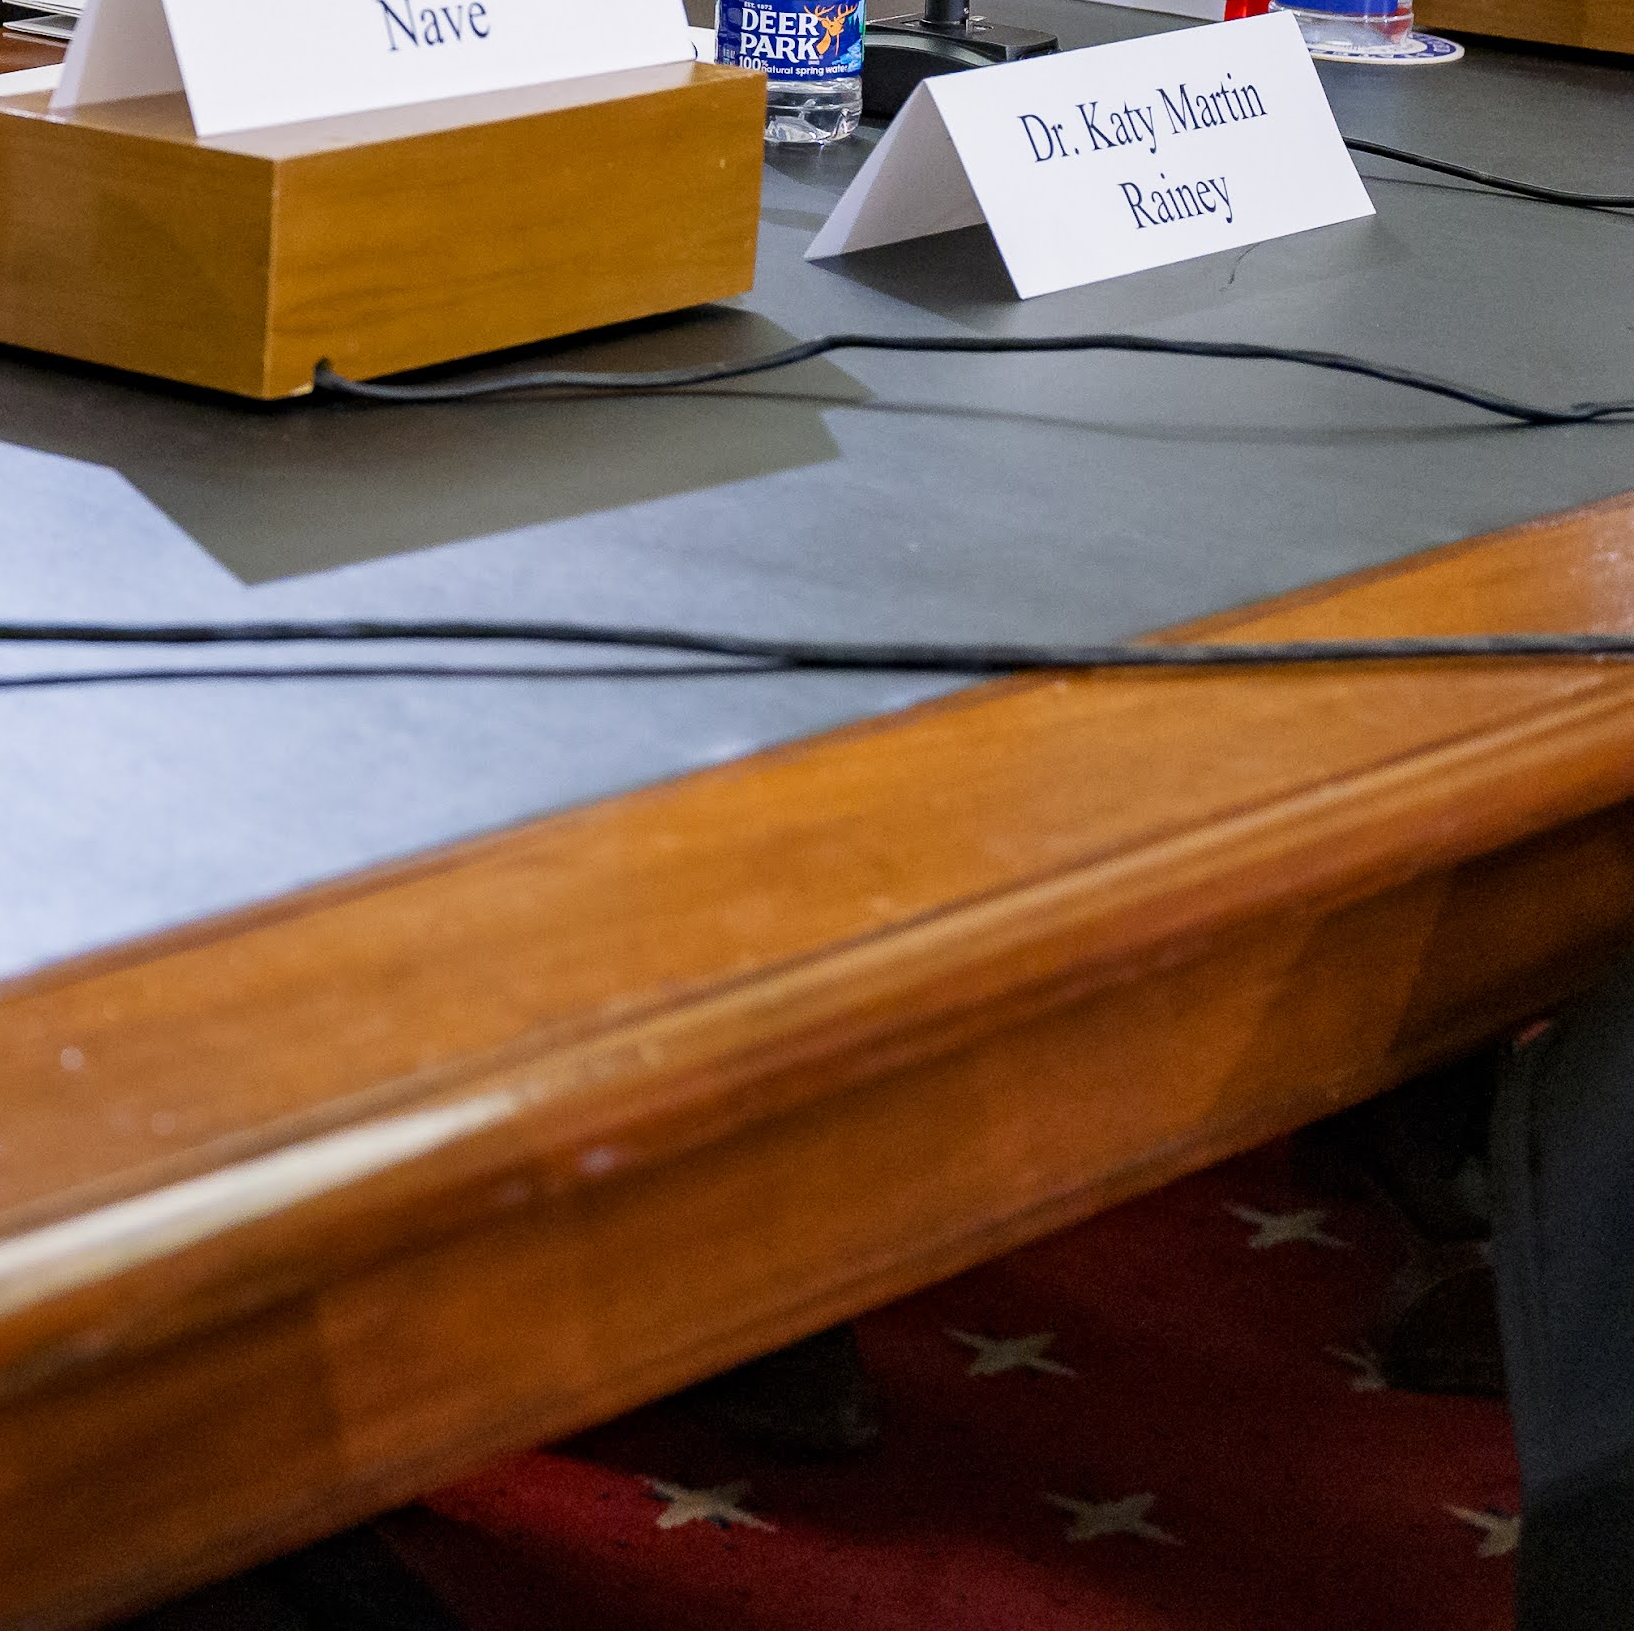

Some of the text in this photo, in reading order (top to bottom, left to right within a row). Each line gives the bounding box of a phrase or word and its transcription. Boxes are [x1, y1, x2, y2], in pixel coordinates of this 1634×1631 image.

[741, 7, 820, 36] DEER
[739, 32, 820, 64] PARK
[795, 65, 825, 77] spring
[825, 64, 849, 74] water
[1017, 71, 1268, 163] Dr. Katy Martin
[1117, 173, 1233, 230] Rainey
